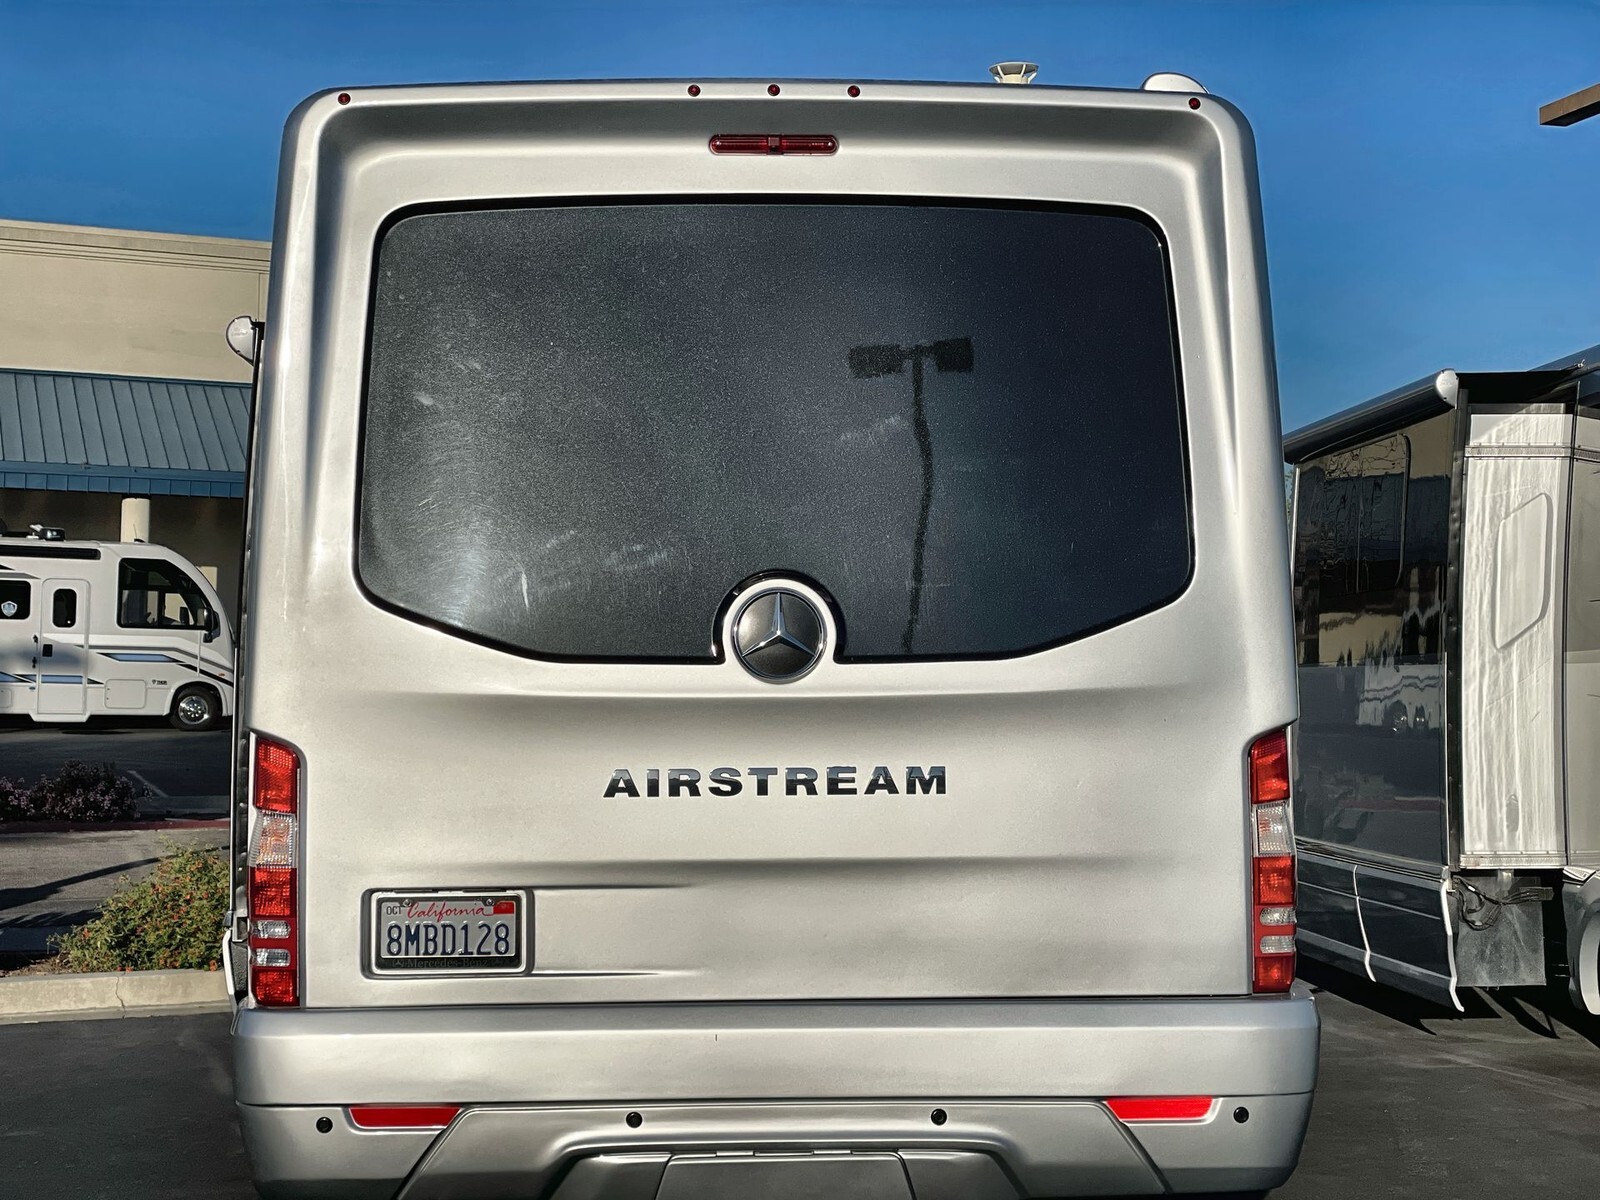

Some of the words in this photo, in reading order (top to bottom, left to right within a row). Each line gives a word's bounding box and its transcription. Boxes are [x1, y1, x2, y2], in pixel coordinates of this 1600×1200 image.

[603, 766, 946, 798] AIRSTREAM
[386, 905, 402, 916] OCT
[407, 902, 490, 922] California
[386, 923, 510, 956] 8MBD128
[408, 958, 488, 969] Mercedes-Benz
